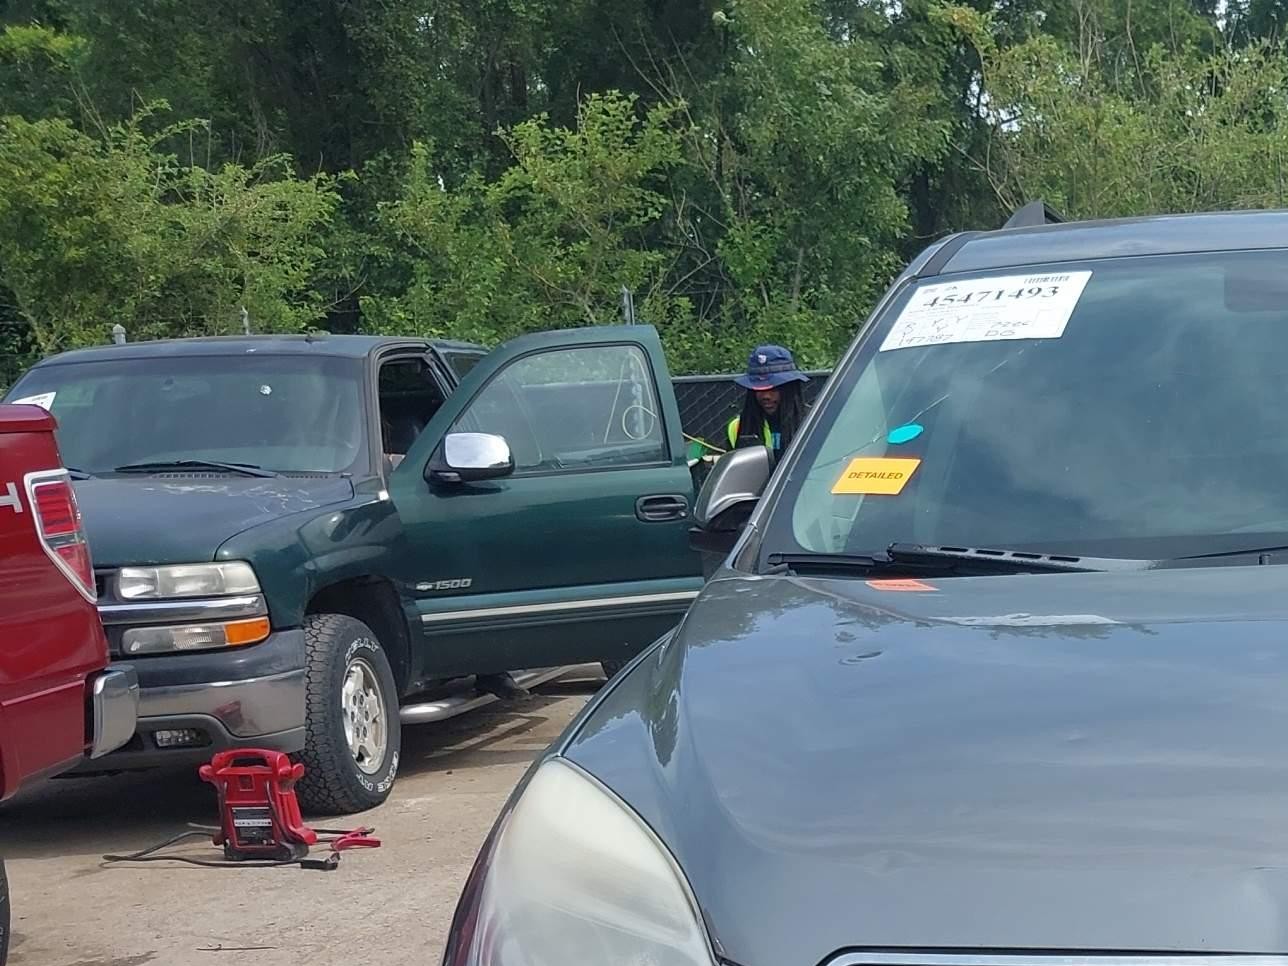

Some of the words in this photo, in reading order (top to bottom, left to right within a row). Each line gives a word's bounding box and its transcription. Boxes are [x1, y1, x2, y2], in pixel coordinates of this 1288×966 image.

[923, 286, 1060, 307] 45471493
[848, 471, 904, 480] DETAILED
[435, 578, 473, 590] 1500
